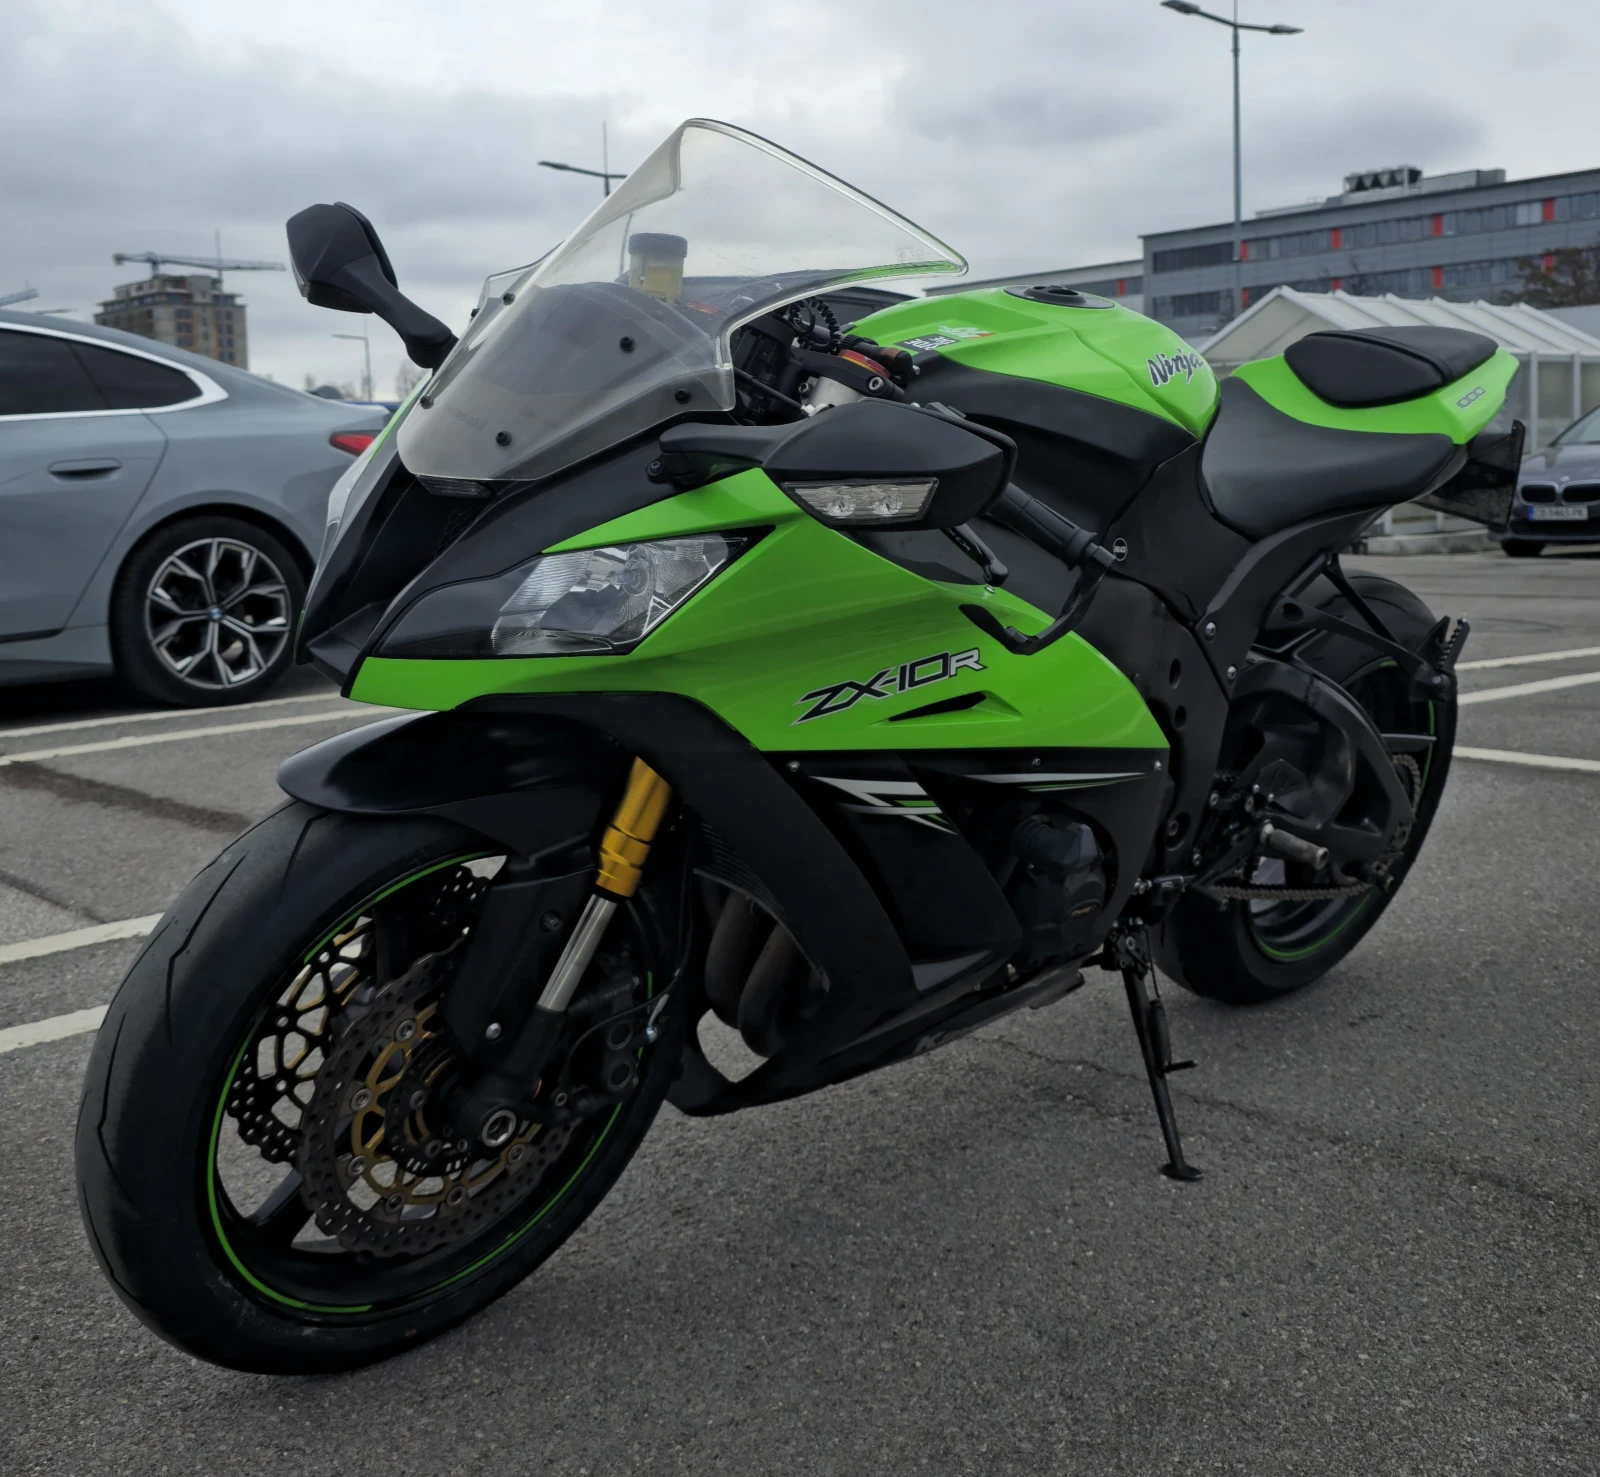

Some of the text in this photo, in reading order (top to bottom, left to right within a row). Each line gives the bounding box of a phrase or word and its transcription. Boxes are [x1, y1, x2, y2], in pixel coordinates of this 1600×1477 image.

[1146, 348, 1204, 387] Ninja
[1456, 386, 1486, 409] 1000
[788, 647, 988, 727] ZX-10R
